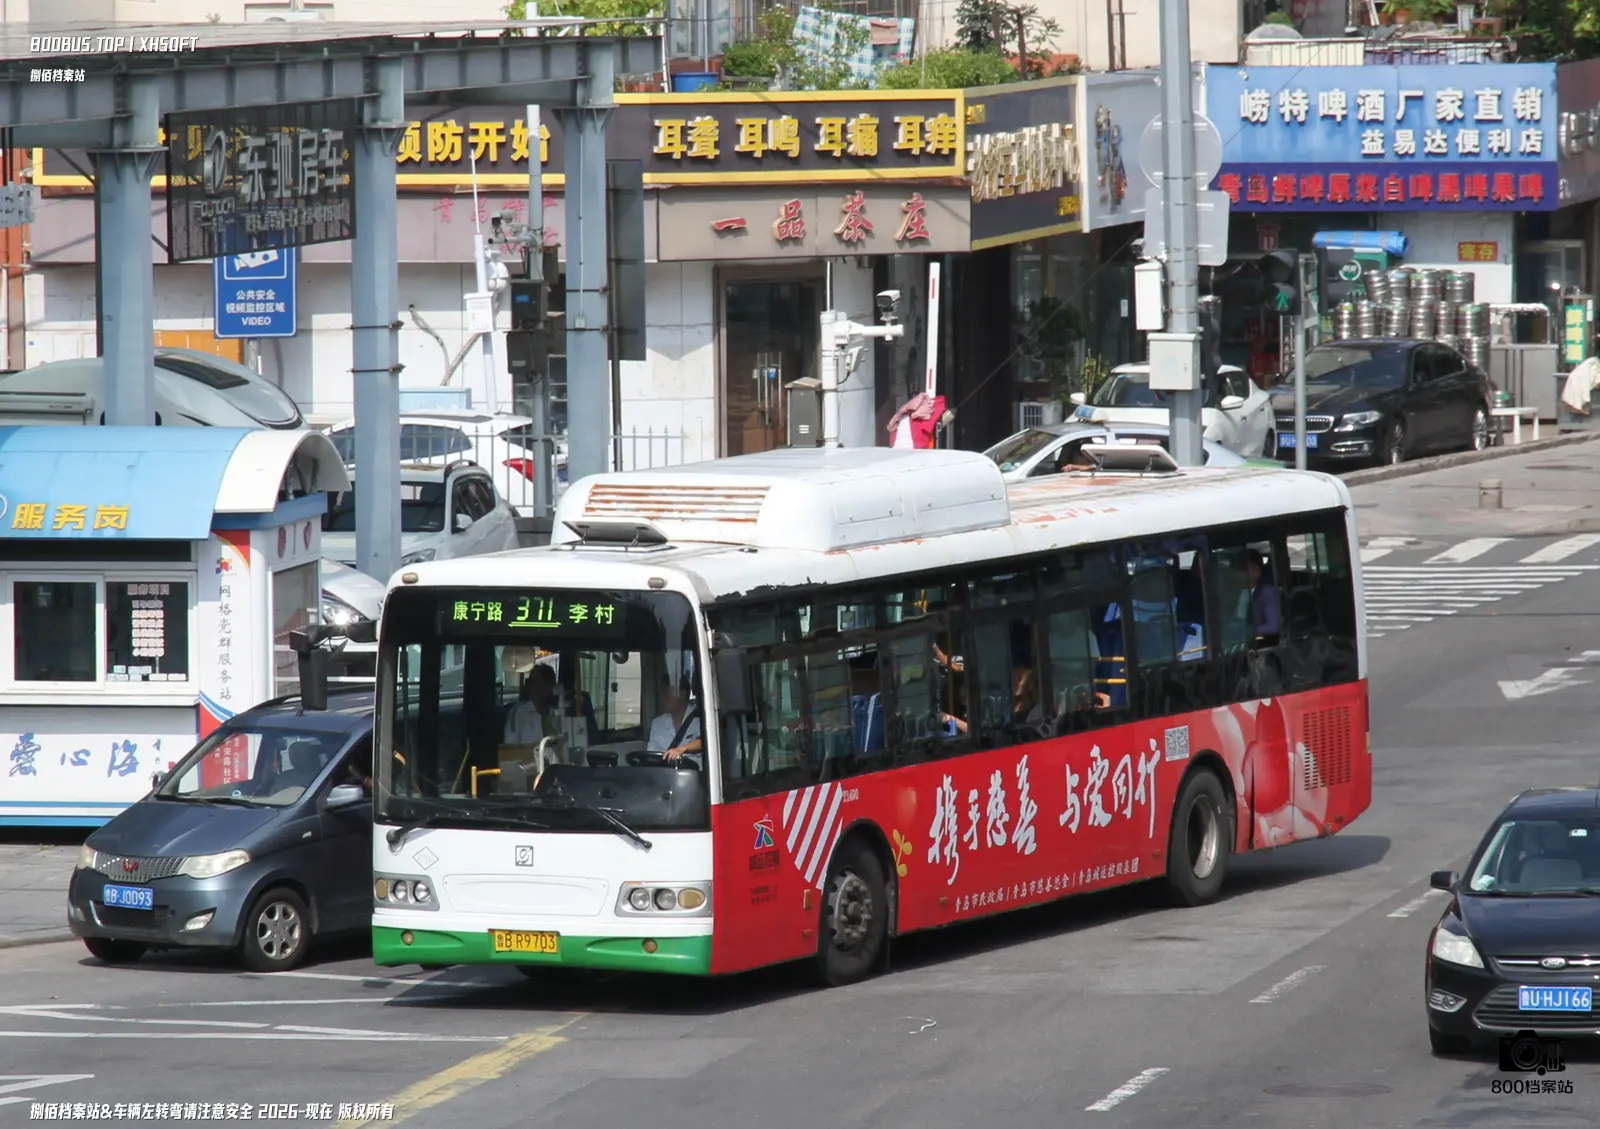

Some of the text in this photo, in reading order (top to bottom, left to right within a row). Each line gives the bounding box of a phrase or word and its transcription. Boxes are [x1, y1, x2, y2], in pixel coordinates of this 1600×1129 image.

[1240, 87, 1544, 123] 崂特啤酒厂家直销
[654, 115, 720, 159] 耳聋
[735, 114, 800, 157] 耳鸣
[815, 112, 880, 156] 耳痛
[893, 112, 957, 155] 耳痒
[1361, 128, 1544, 155] 益易达便利店
[710, 190, 930, 242] 一品茶庄
[225, 302, 286, 314] 视频监控区域
[235, 289, 276, 301] 公共安全
[241, 316, 272, 326] VIDEO
[11, 503, 130, 530] 服务岗
[453, 596, 615, 625] 康宁路 371 李村
[217, 584, 233, 701] 网格党群服务站
